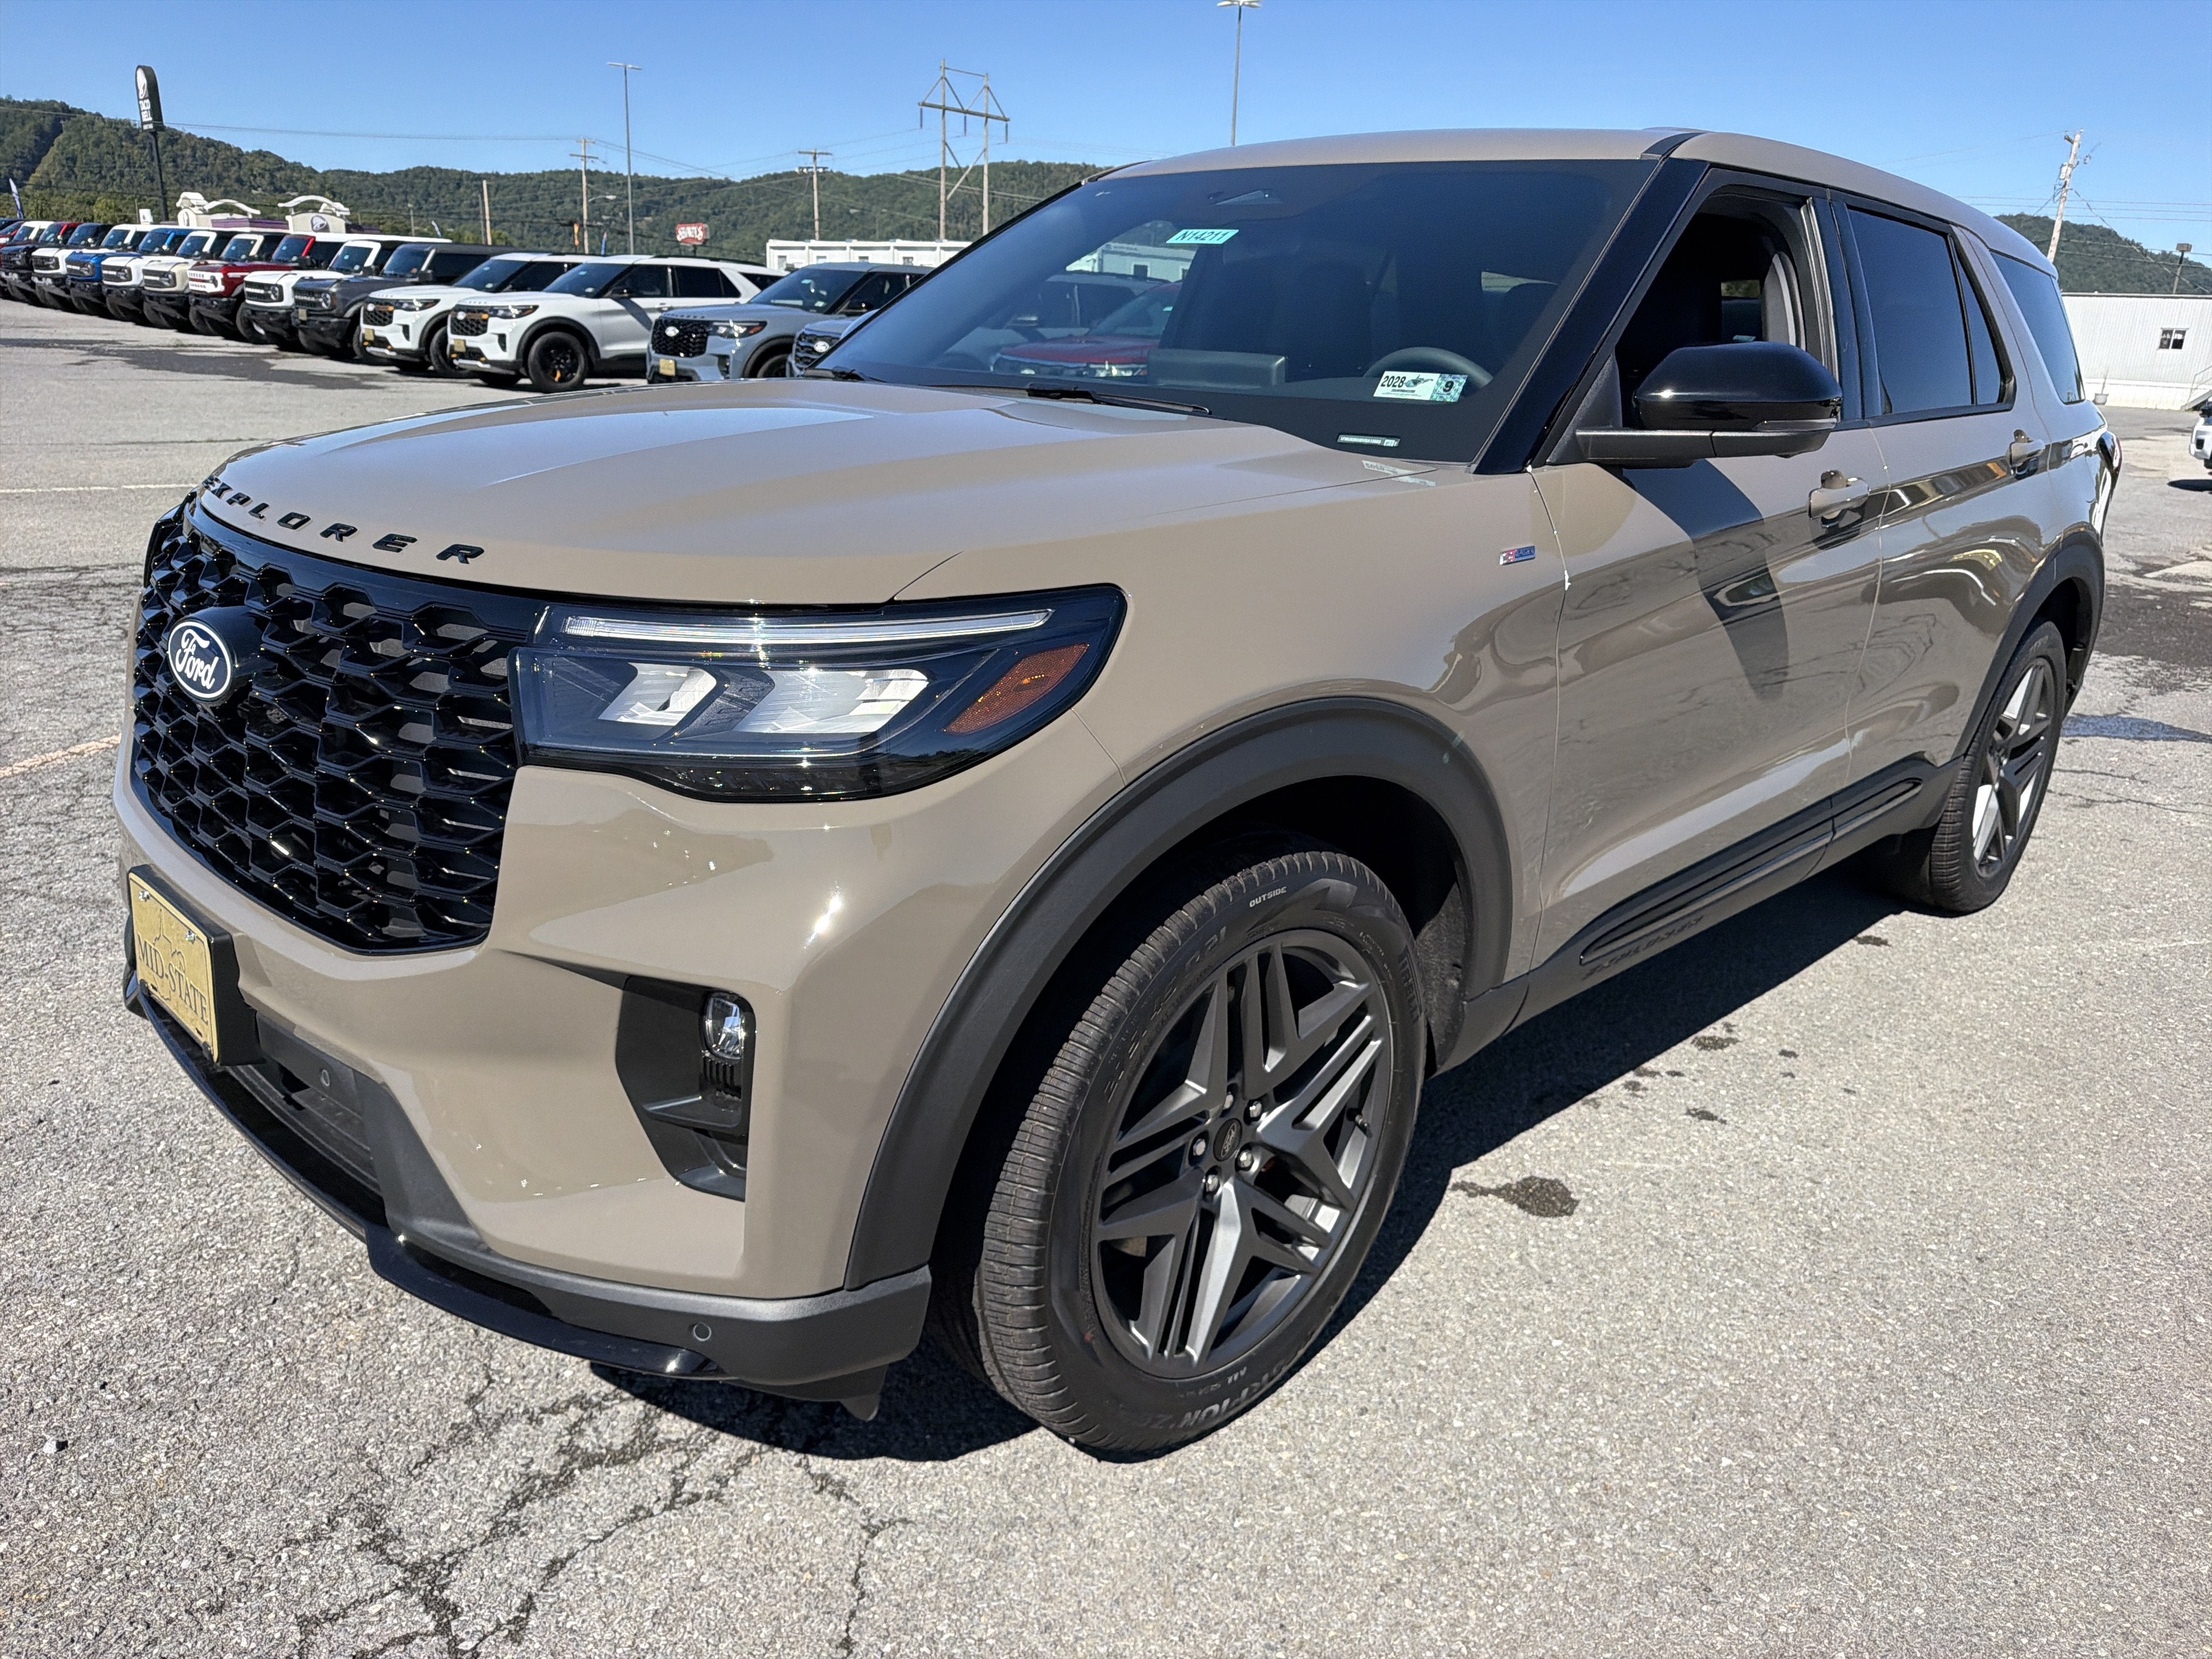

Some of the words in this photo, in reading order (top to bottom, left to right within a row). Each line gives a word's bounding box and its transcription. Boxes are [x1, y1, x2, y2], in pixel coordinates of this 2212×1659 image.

[1175, 231, 1229, 241] N14211
[1380, 375, 1407, 388] 2028
[1442, 380, 1454, 393] 9
[201, 475, 486, 565] EXPLORER
[175, 629, 219, 690] Ford
[1249, 886, 1288, 908] OUTSIDE
